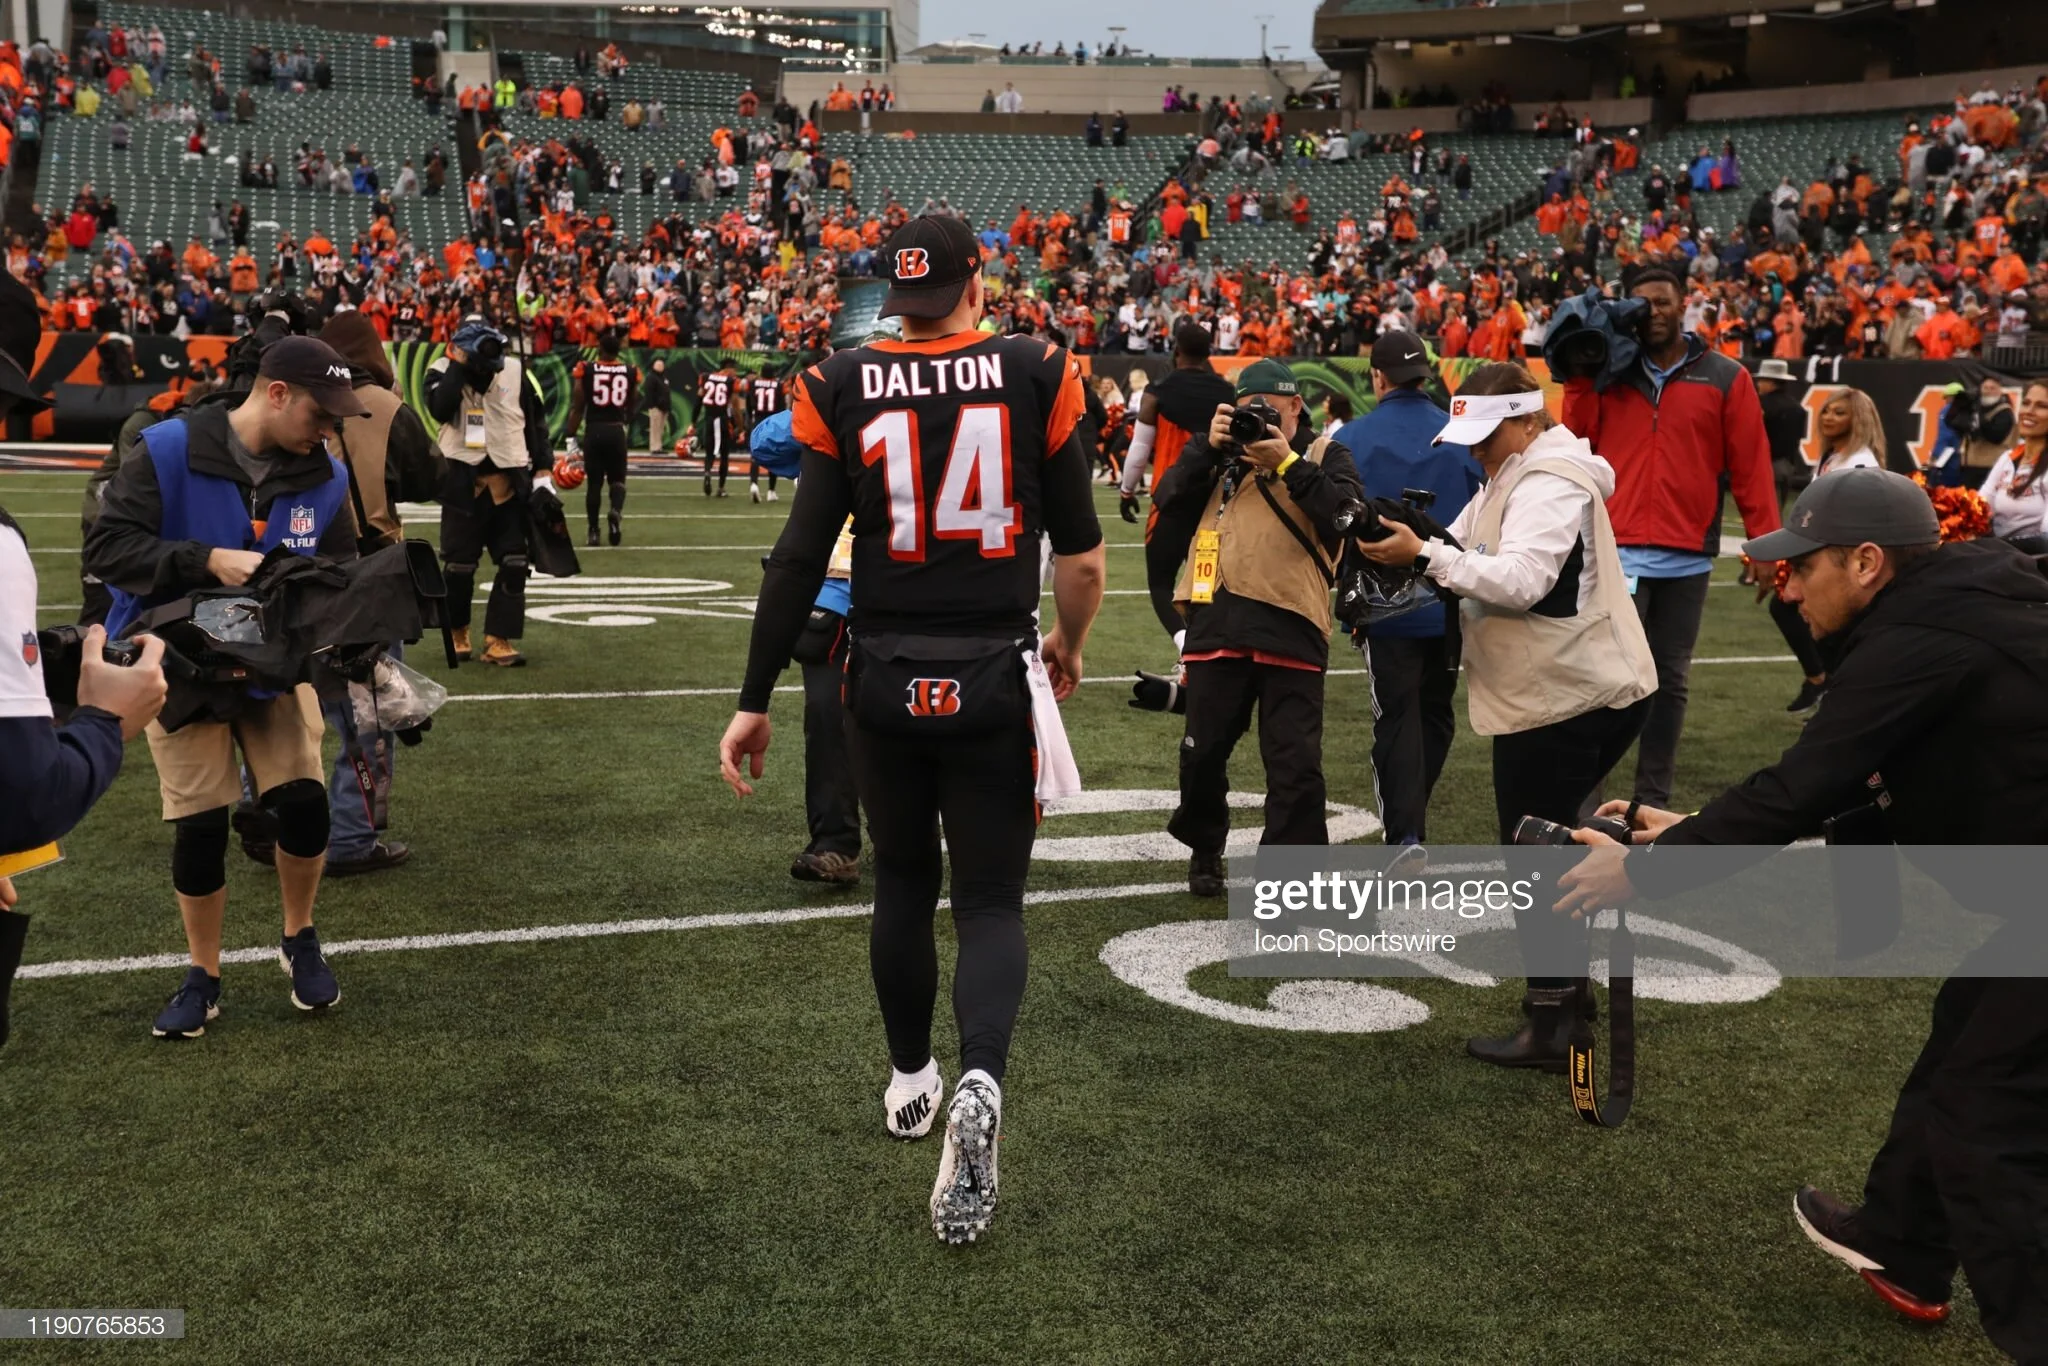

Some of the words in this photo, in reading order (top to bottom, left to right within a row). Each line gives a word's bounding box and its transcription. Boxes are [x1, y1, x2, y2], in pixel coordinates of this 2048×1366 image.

[592, 374, 628, 407] 58
[861, 353, 1004, 400] DALTON
[702, 381, 728, 407] 26
[754, 387, 775, 412] 11
[858, 403, 1024, 563] 14
[291, 517, 313, 532] NFL
[1196, 562, 1213, 578] 10
[1576, 1052, 1586, 1084] Nikon
[895, 1091, 932, 1131] NIKE
[1575, 1086, 1593, 1111] D5
